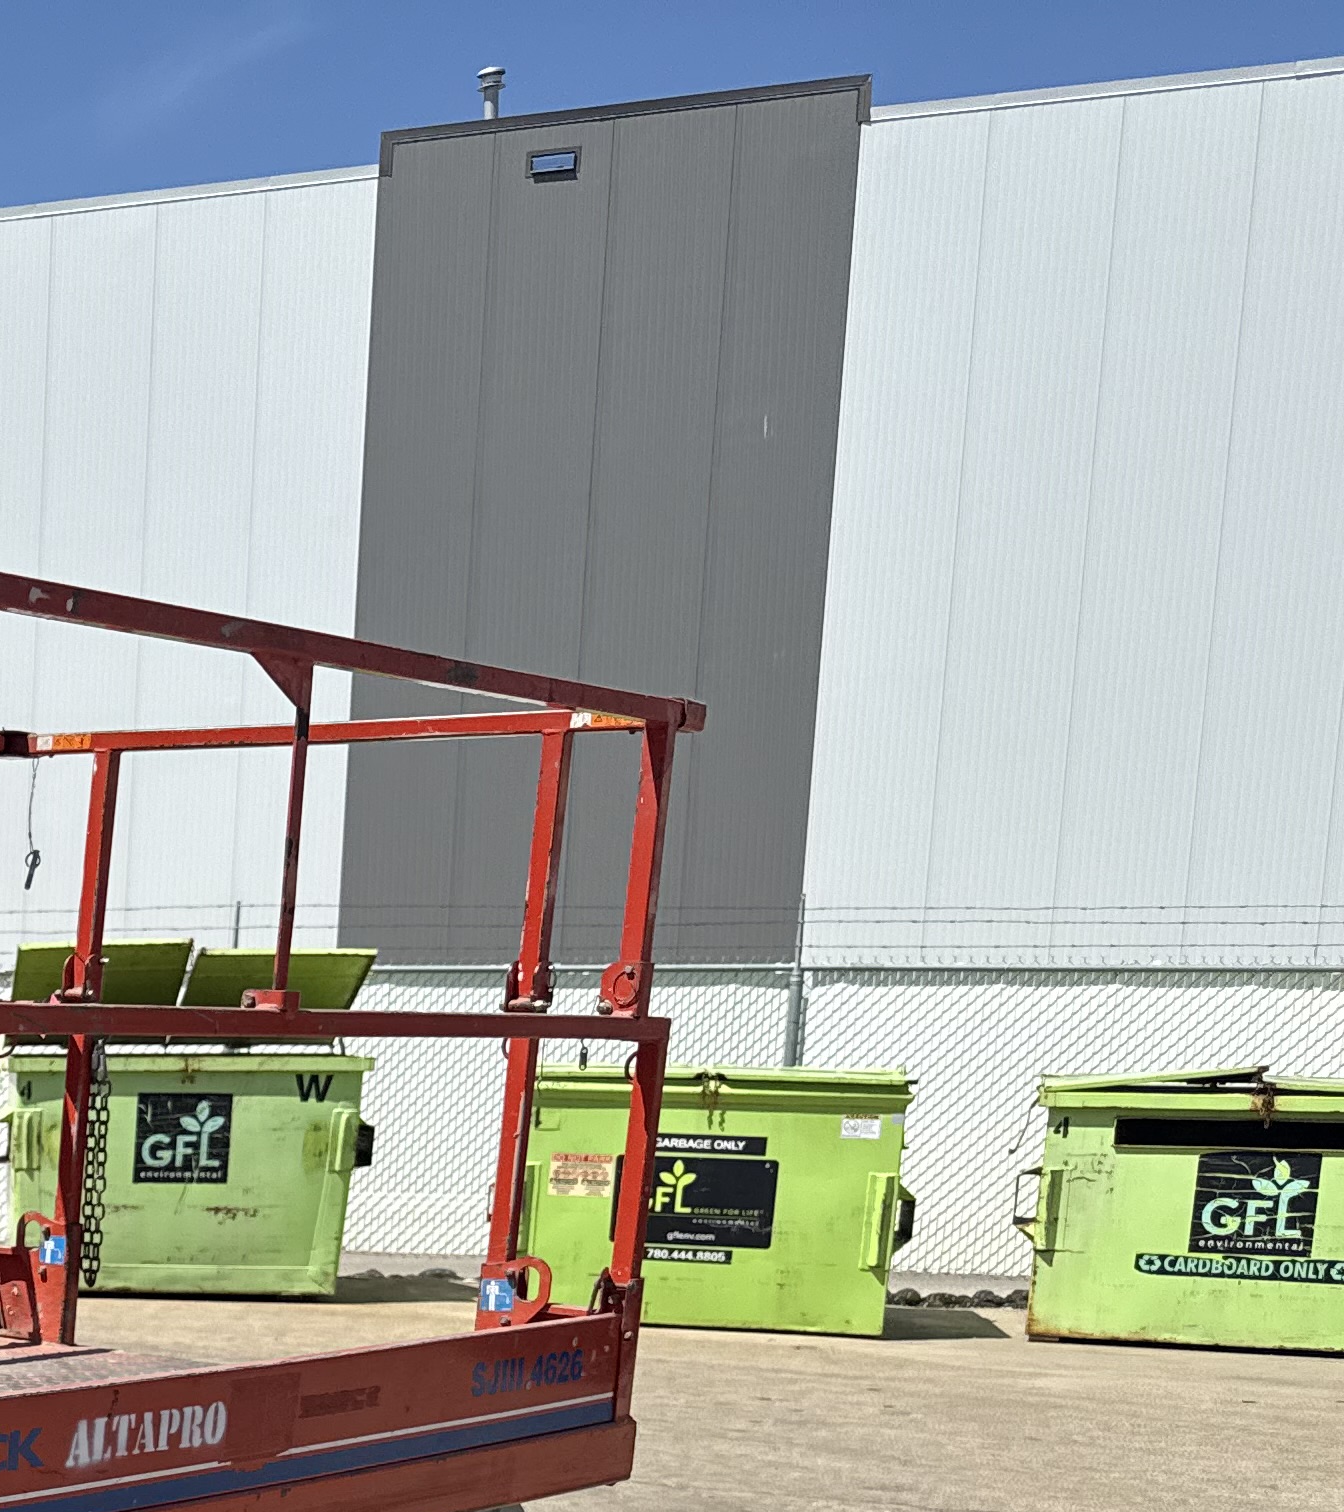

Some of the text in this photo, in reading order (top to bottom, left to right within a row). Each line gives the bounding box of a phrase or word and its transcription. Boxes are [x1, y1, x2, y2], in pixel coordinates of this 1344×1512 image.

[295, 1073, 334, 1102] W
[141, 1115, 224, 1168] GFL
[713, 1139, 746, 1151] ONLY
[648, 1173, 695, 1214] FL
[1201, 1180, 1307, 1238] GFL
[1198, 1239, 1304, 1251] environmental
[1163, 1256, 1328, 1280] CARDBOARD ONLY
[531, 1348, 583, 1387] 4626
[65, 1400, 227, 1469] ALTAPRO
